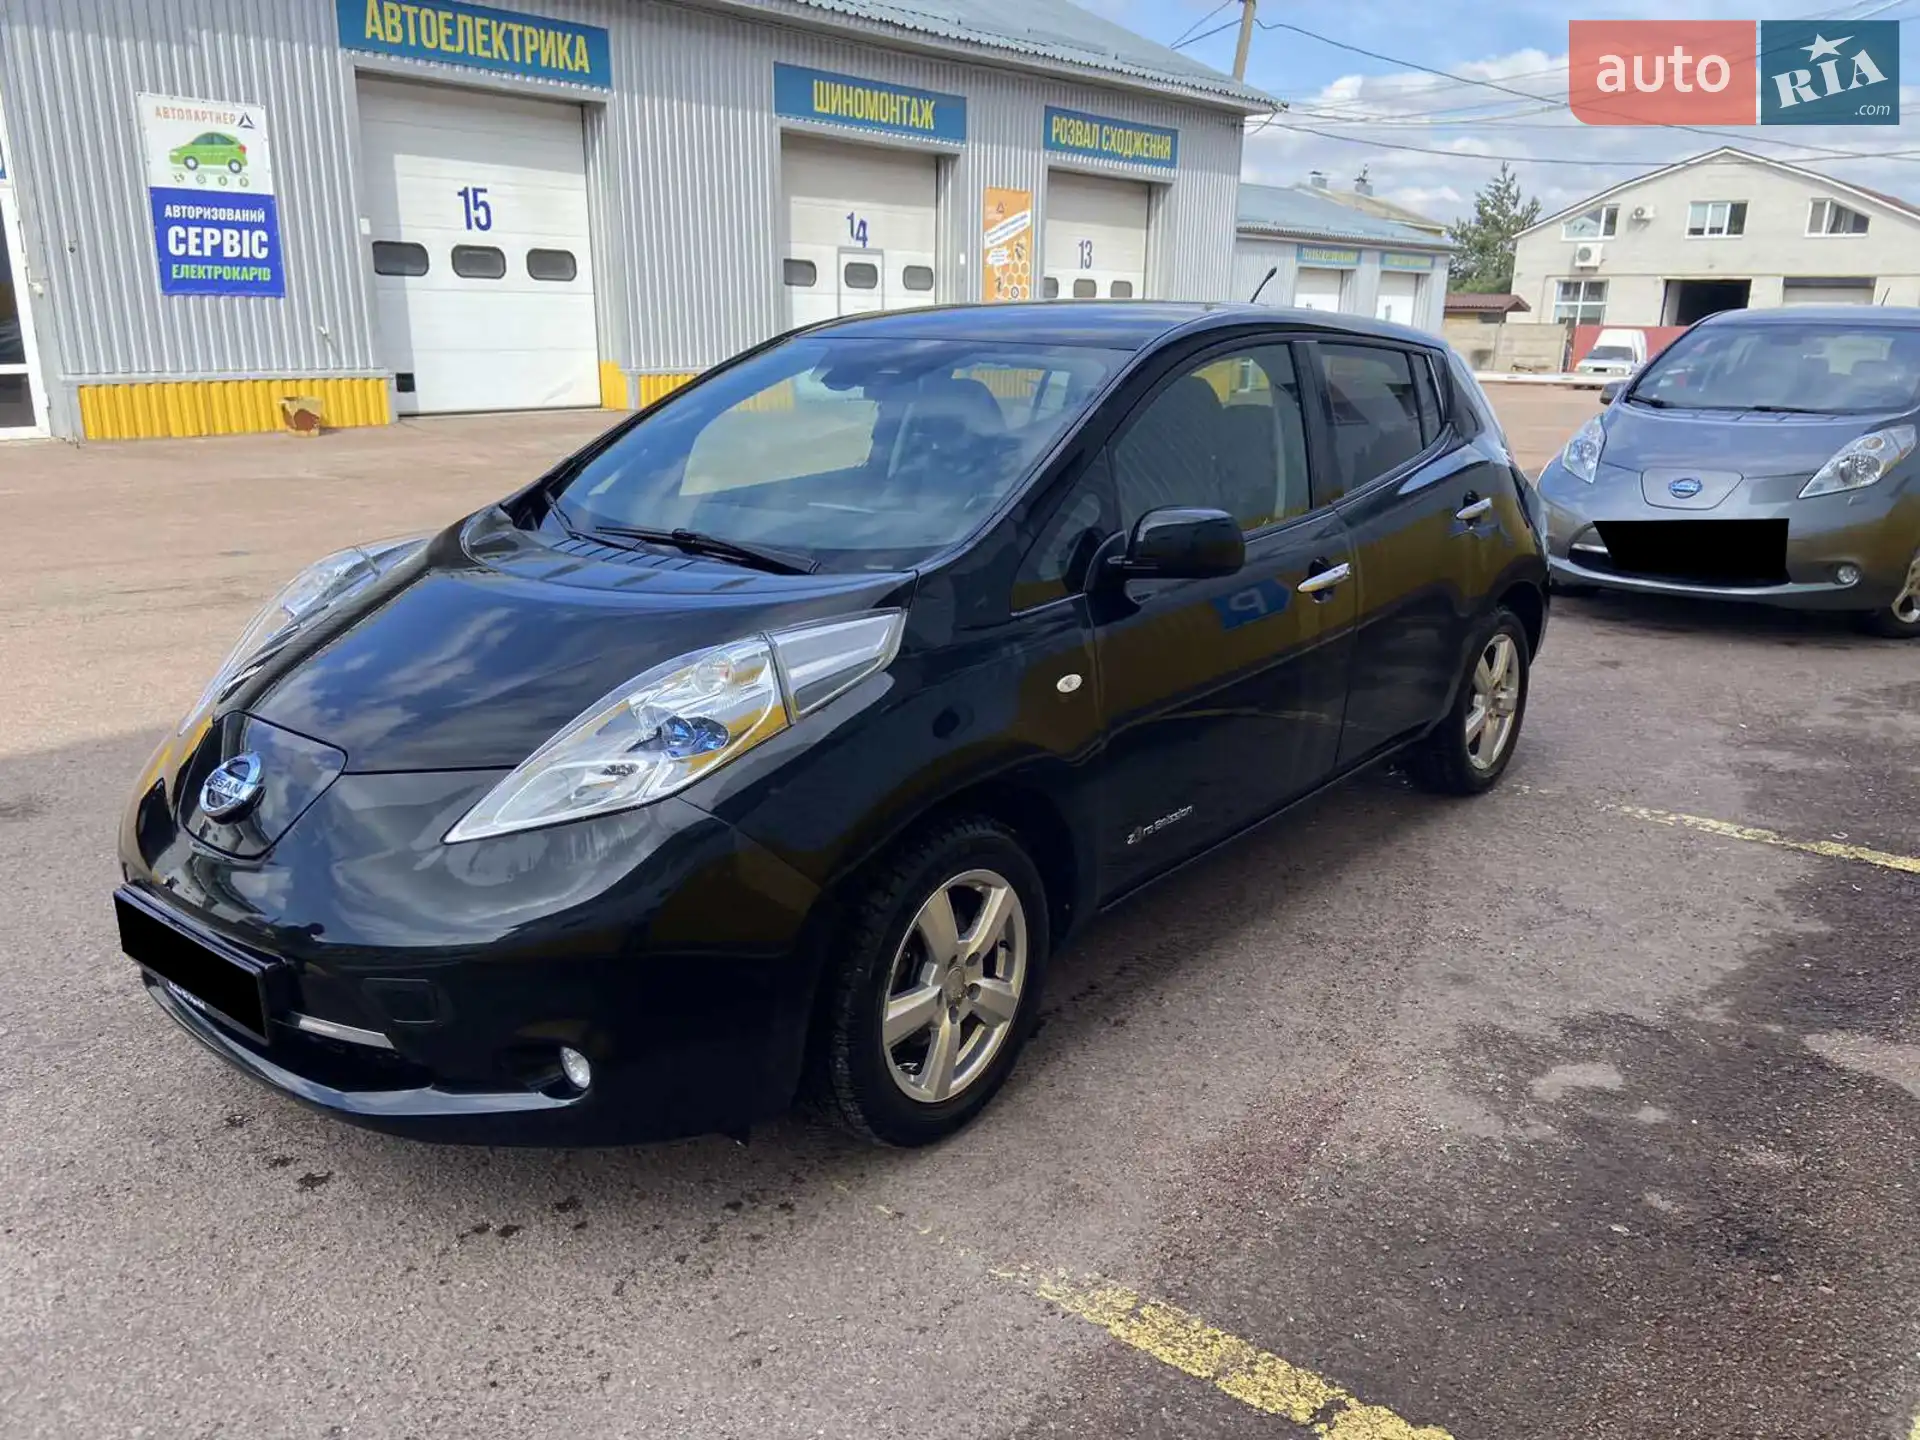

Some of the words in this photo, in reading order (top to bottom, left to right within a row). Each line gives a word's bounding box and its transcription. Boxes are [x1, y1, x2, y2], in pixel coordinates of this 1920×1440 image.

[364, 0, 591, 74] АВТОЕЛЕКТРИКА
[154, 105, 236, 126] АВТОПАРТНЕР
[813, 78, 936, 131] ШИНОМОНТАЖ
[1052, 115, 1100, 151] РОЗВАЛ
[1102, 126, 1172, 161] СХОДЖЕННЯ
[164, 203, 266, 224] АВТОРИЗОВАНИЙ
[457, 187, 493, 232] 15
[167, 225, 269, 260] СЕРВІС
[846, 211, 869, 249] 14
[171, 263, 272, 282] ЕЛЕКТРОКАРІВ
[1078, 239, 1093, 270] 13
